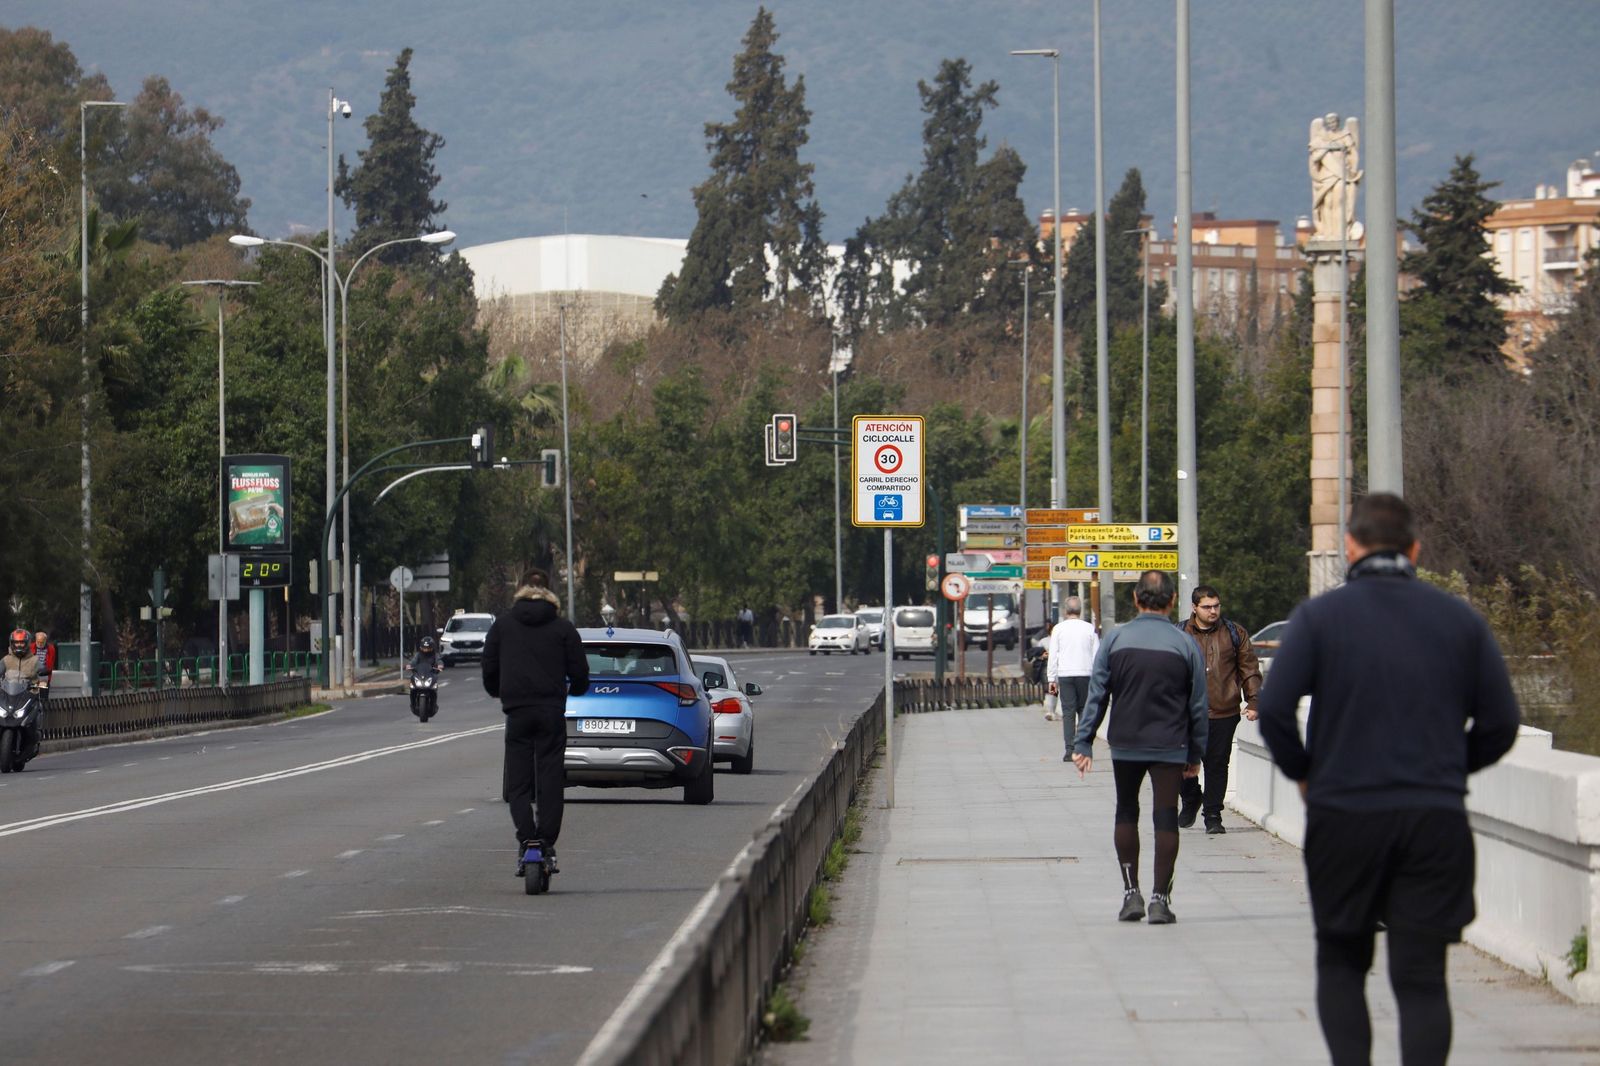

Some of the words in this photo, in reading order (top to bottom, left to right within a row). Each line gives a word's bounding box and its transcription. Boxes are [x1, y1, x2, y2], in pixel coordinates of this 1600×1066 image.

[865, 422, 912, 431] ATENCIÓN
[881, 454, 896, 464] 30
[1150, 529, 1159, 539] P
[1086, 555, 1096, 567] P
[585, 720, 610, 730] 8902
